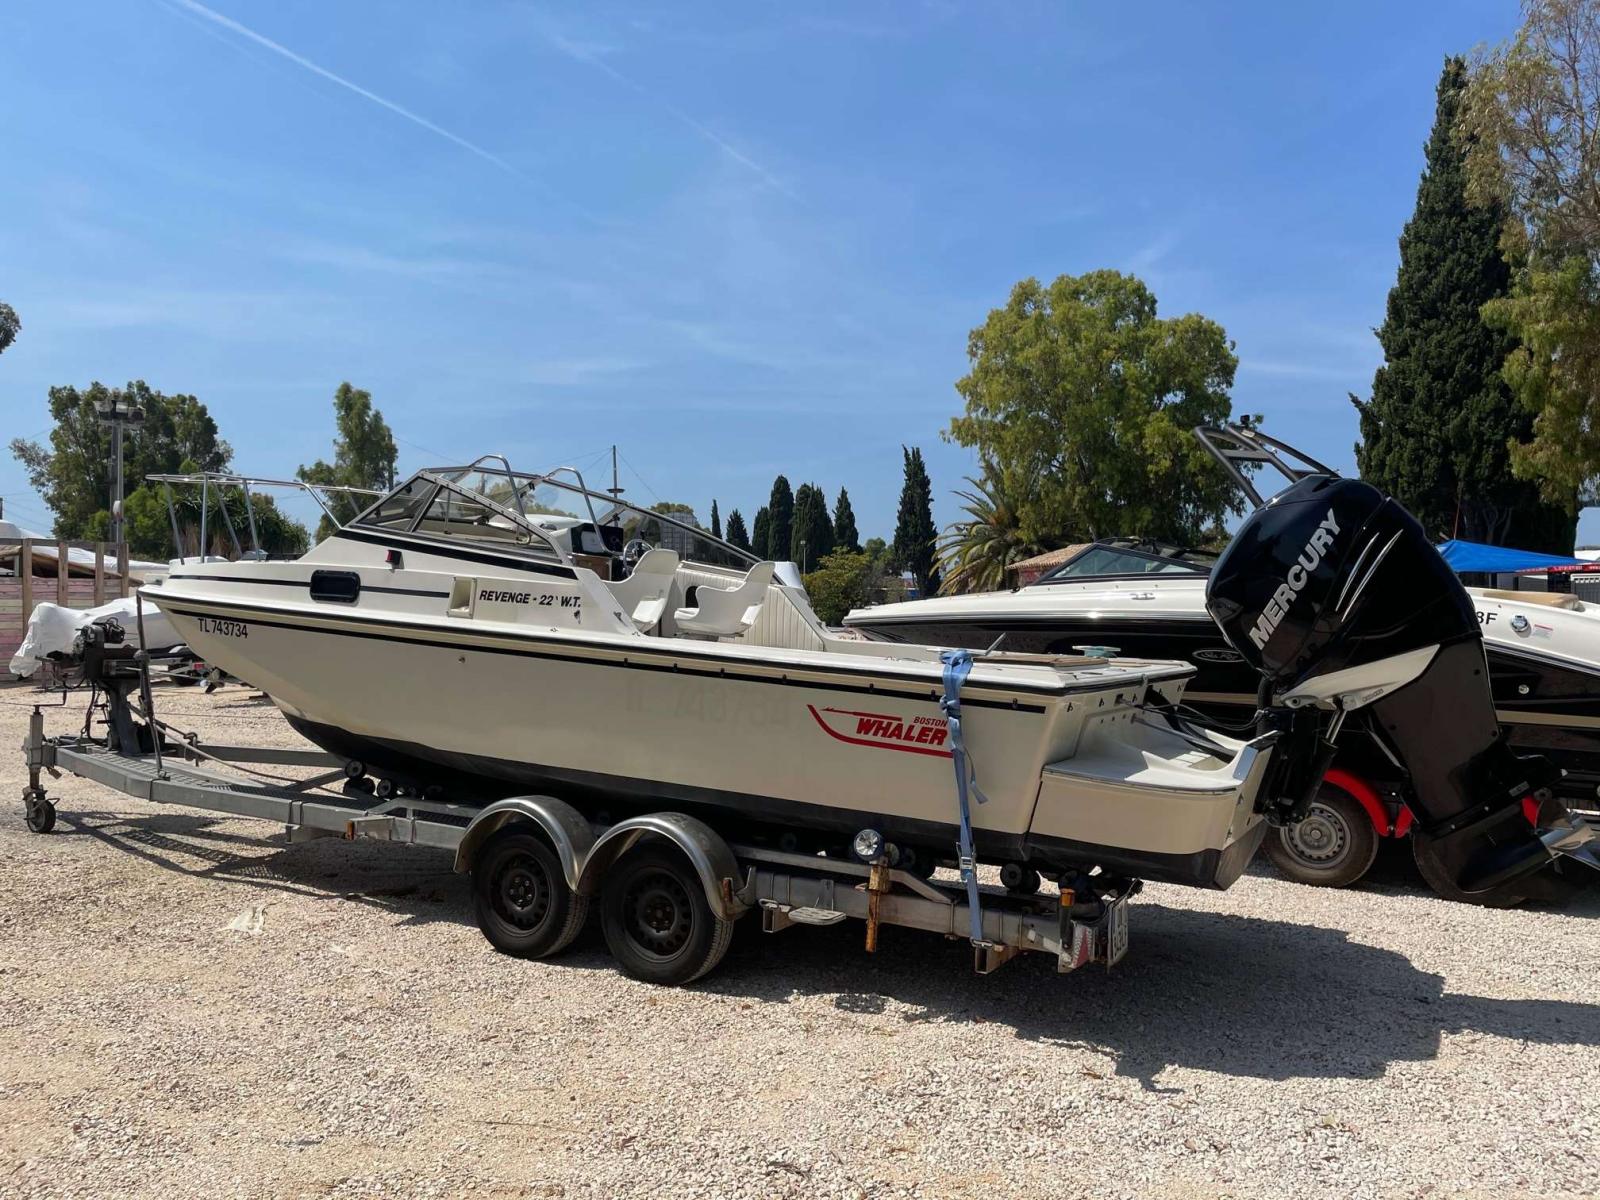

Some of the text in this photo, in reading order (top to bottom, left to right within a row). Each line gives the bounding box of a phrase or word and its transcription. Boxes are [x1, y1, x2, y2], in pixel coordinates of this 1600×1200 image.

[1249, 508, 1341, 651] MERCURY
[479, 589, 531, 605] REVENGE
[560, 595, 582, 609] W.T.
[197, 617, 249, 639] TL 743734
[856, 717, 948, 746] WHALER
[913, 715, 948, 728] BOSTON
